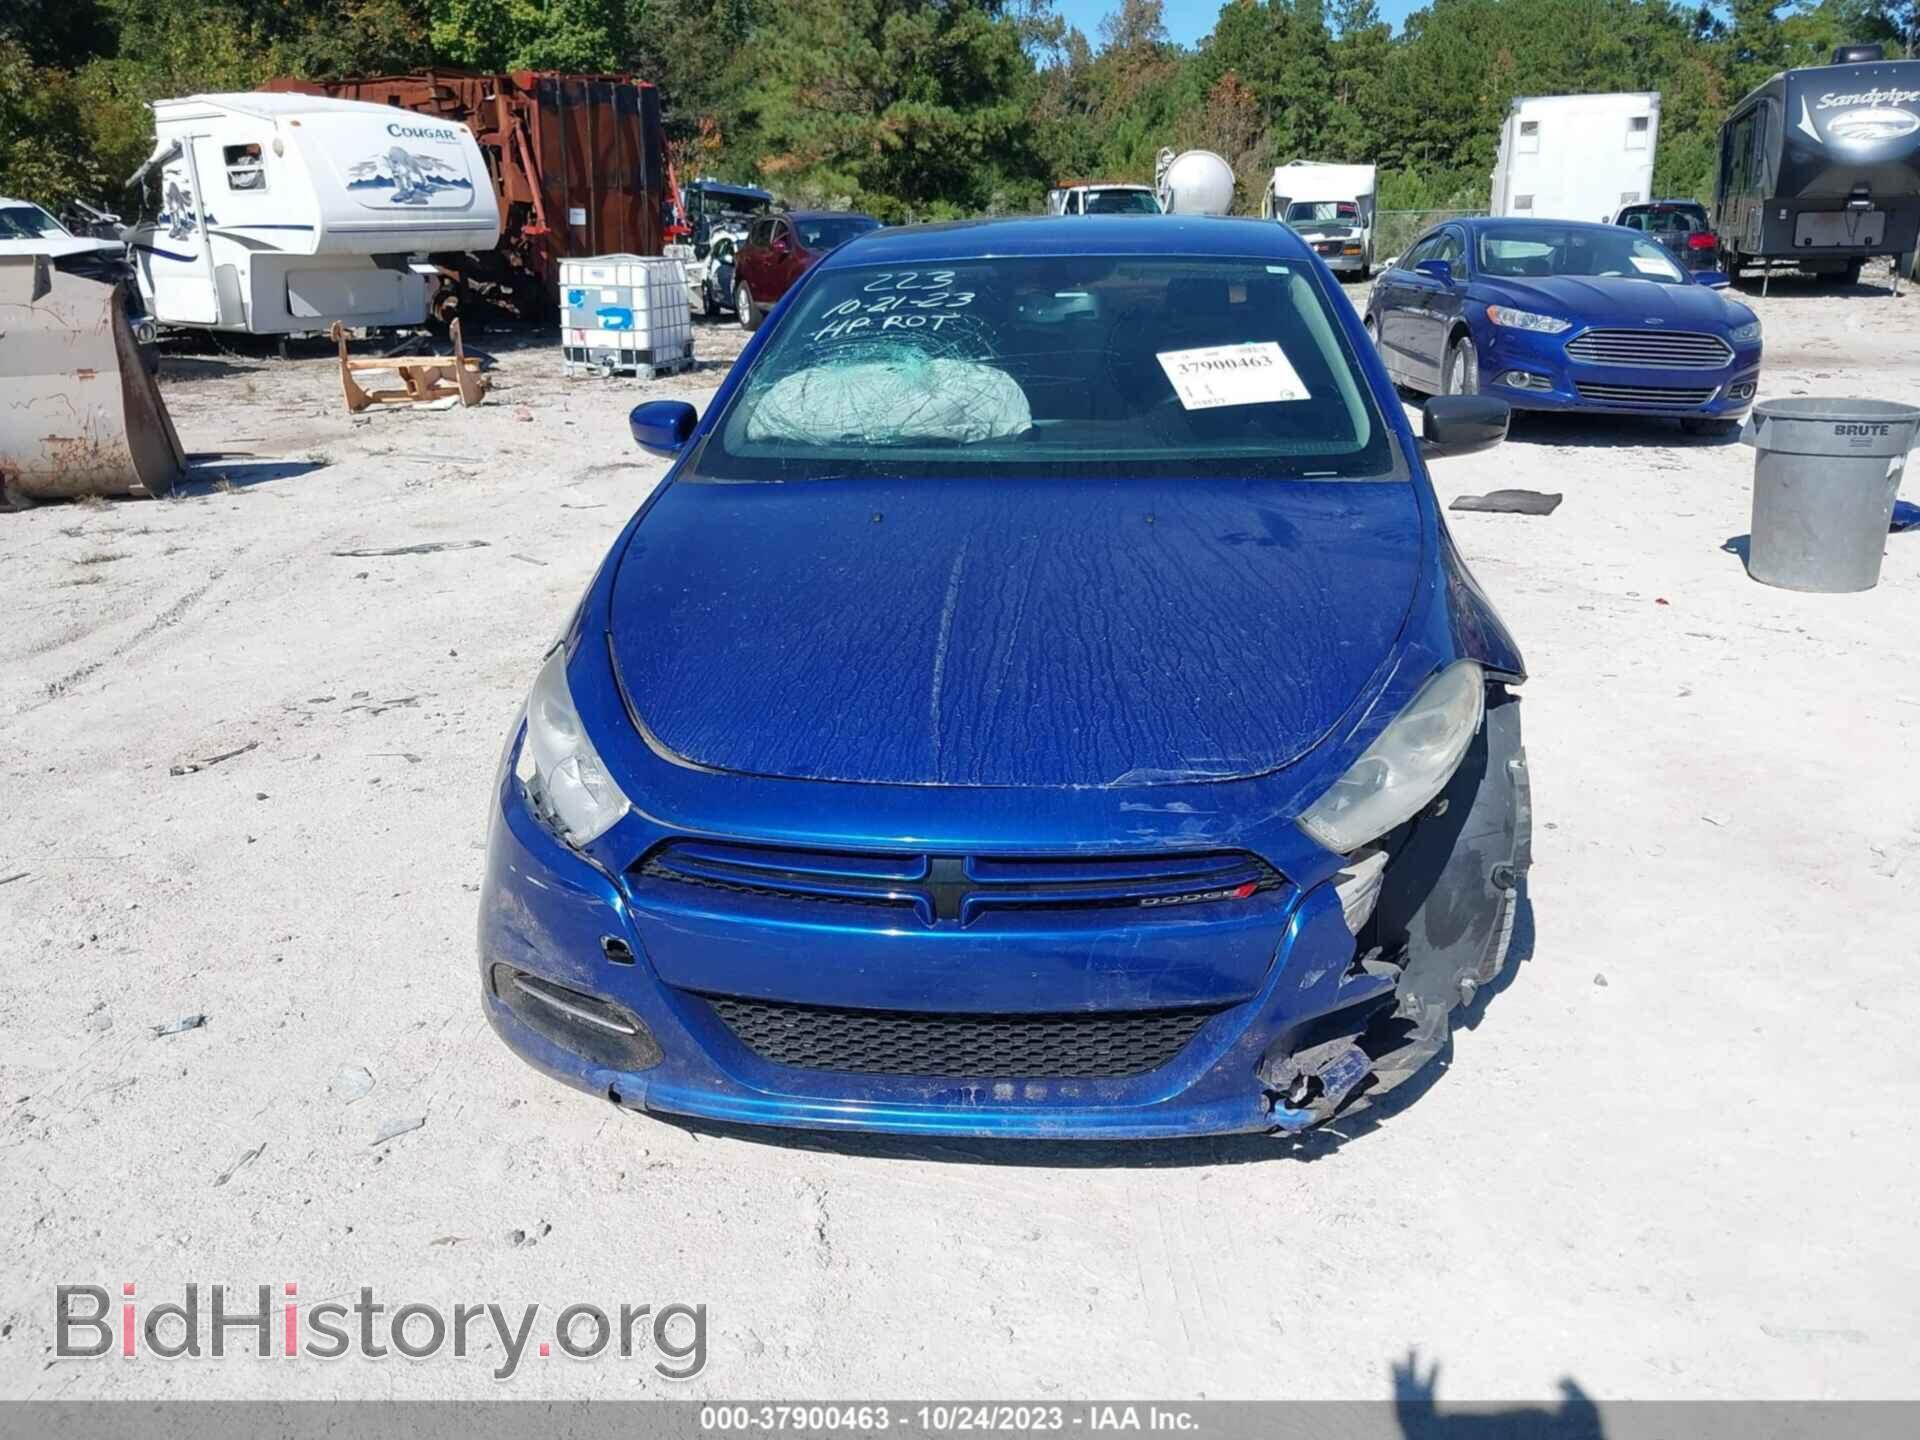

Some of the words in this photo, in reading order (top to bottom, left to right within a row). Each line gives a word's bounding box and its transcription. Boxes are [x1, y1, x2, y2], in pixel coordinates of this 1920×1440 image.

[863, 271, 956, 292] 223
[821, 292, 976, 319] 10-21-23
[882, 314, 961, 331] ROT
[1177, 355, 1273, 376] 37900463
[1834, 424, 1889, 436] BRUTE
